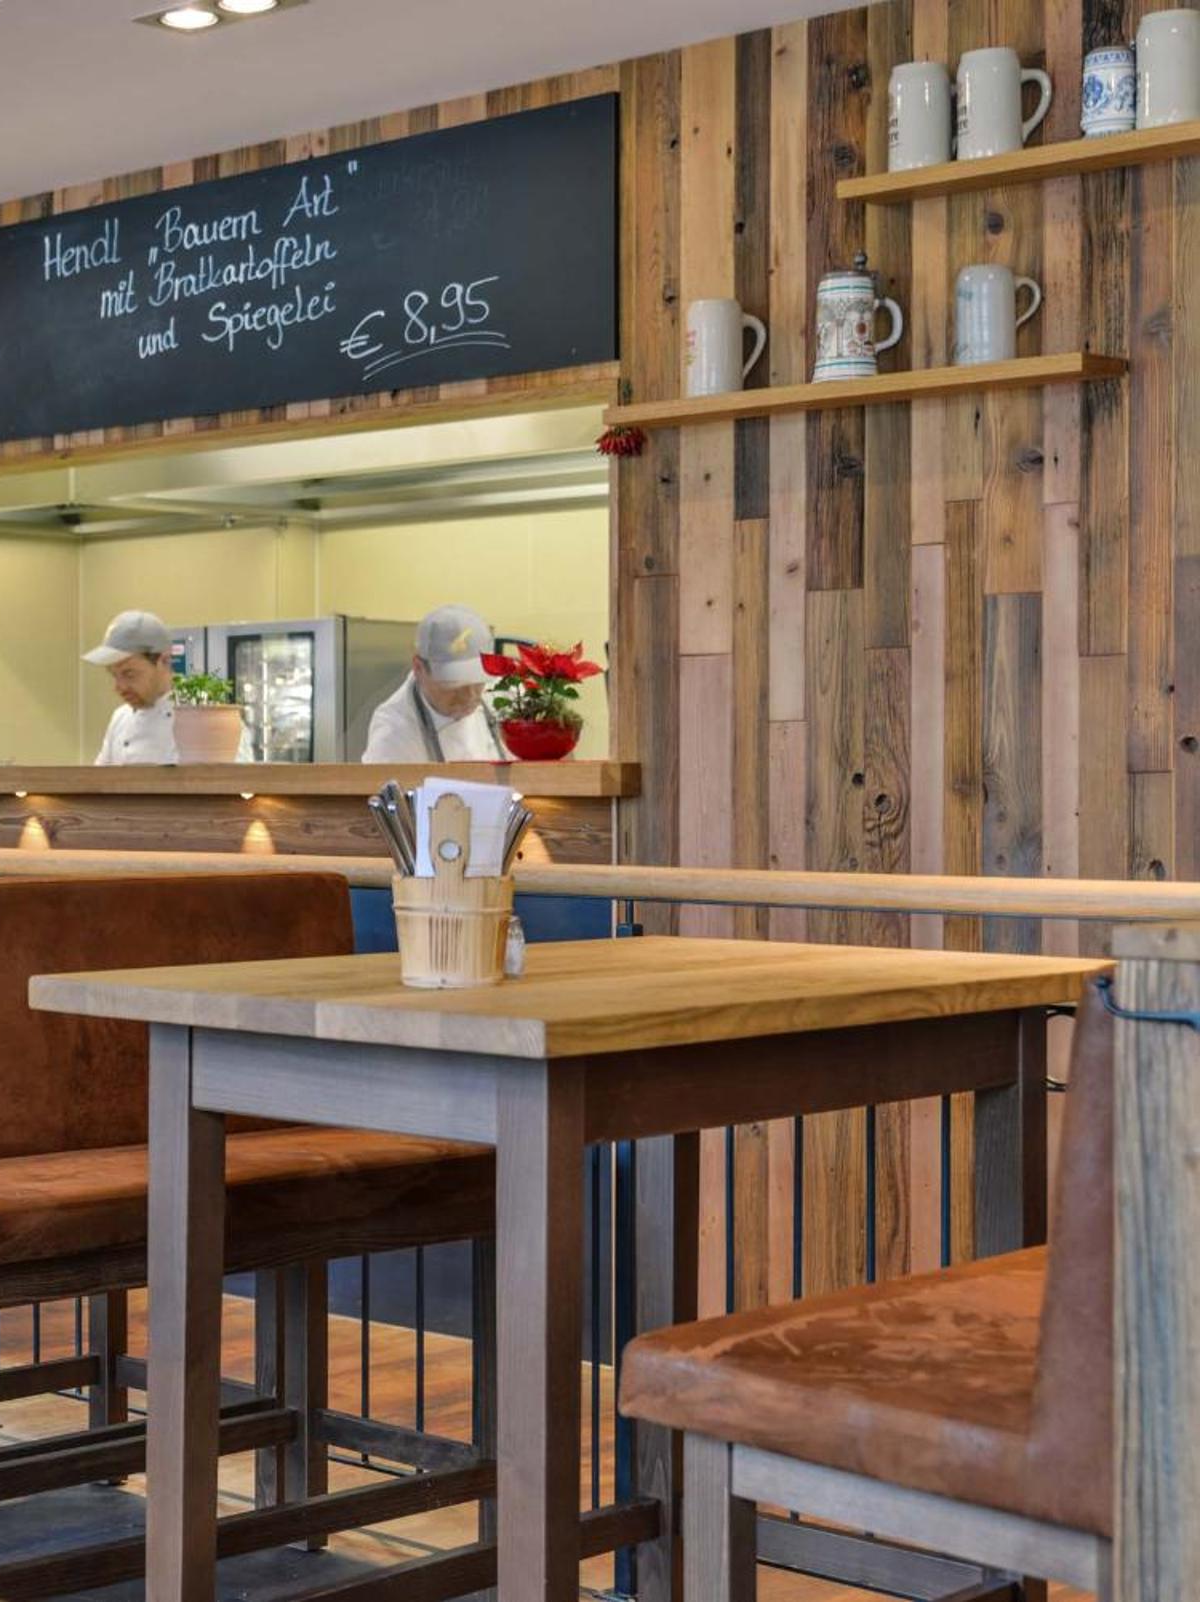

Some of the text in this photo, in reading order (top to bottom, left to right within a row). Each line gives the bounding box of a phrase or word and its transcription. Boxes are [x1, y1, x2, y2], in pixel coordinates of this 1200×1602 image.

[43, 219, 120, 281] Hendl
[100, 234, 337, 319] mit Bratkartoffeln
[138, 283, 336, 360] und Spiegelei
[340, 276, 498, 359] € 8,95
